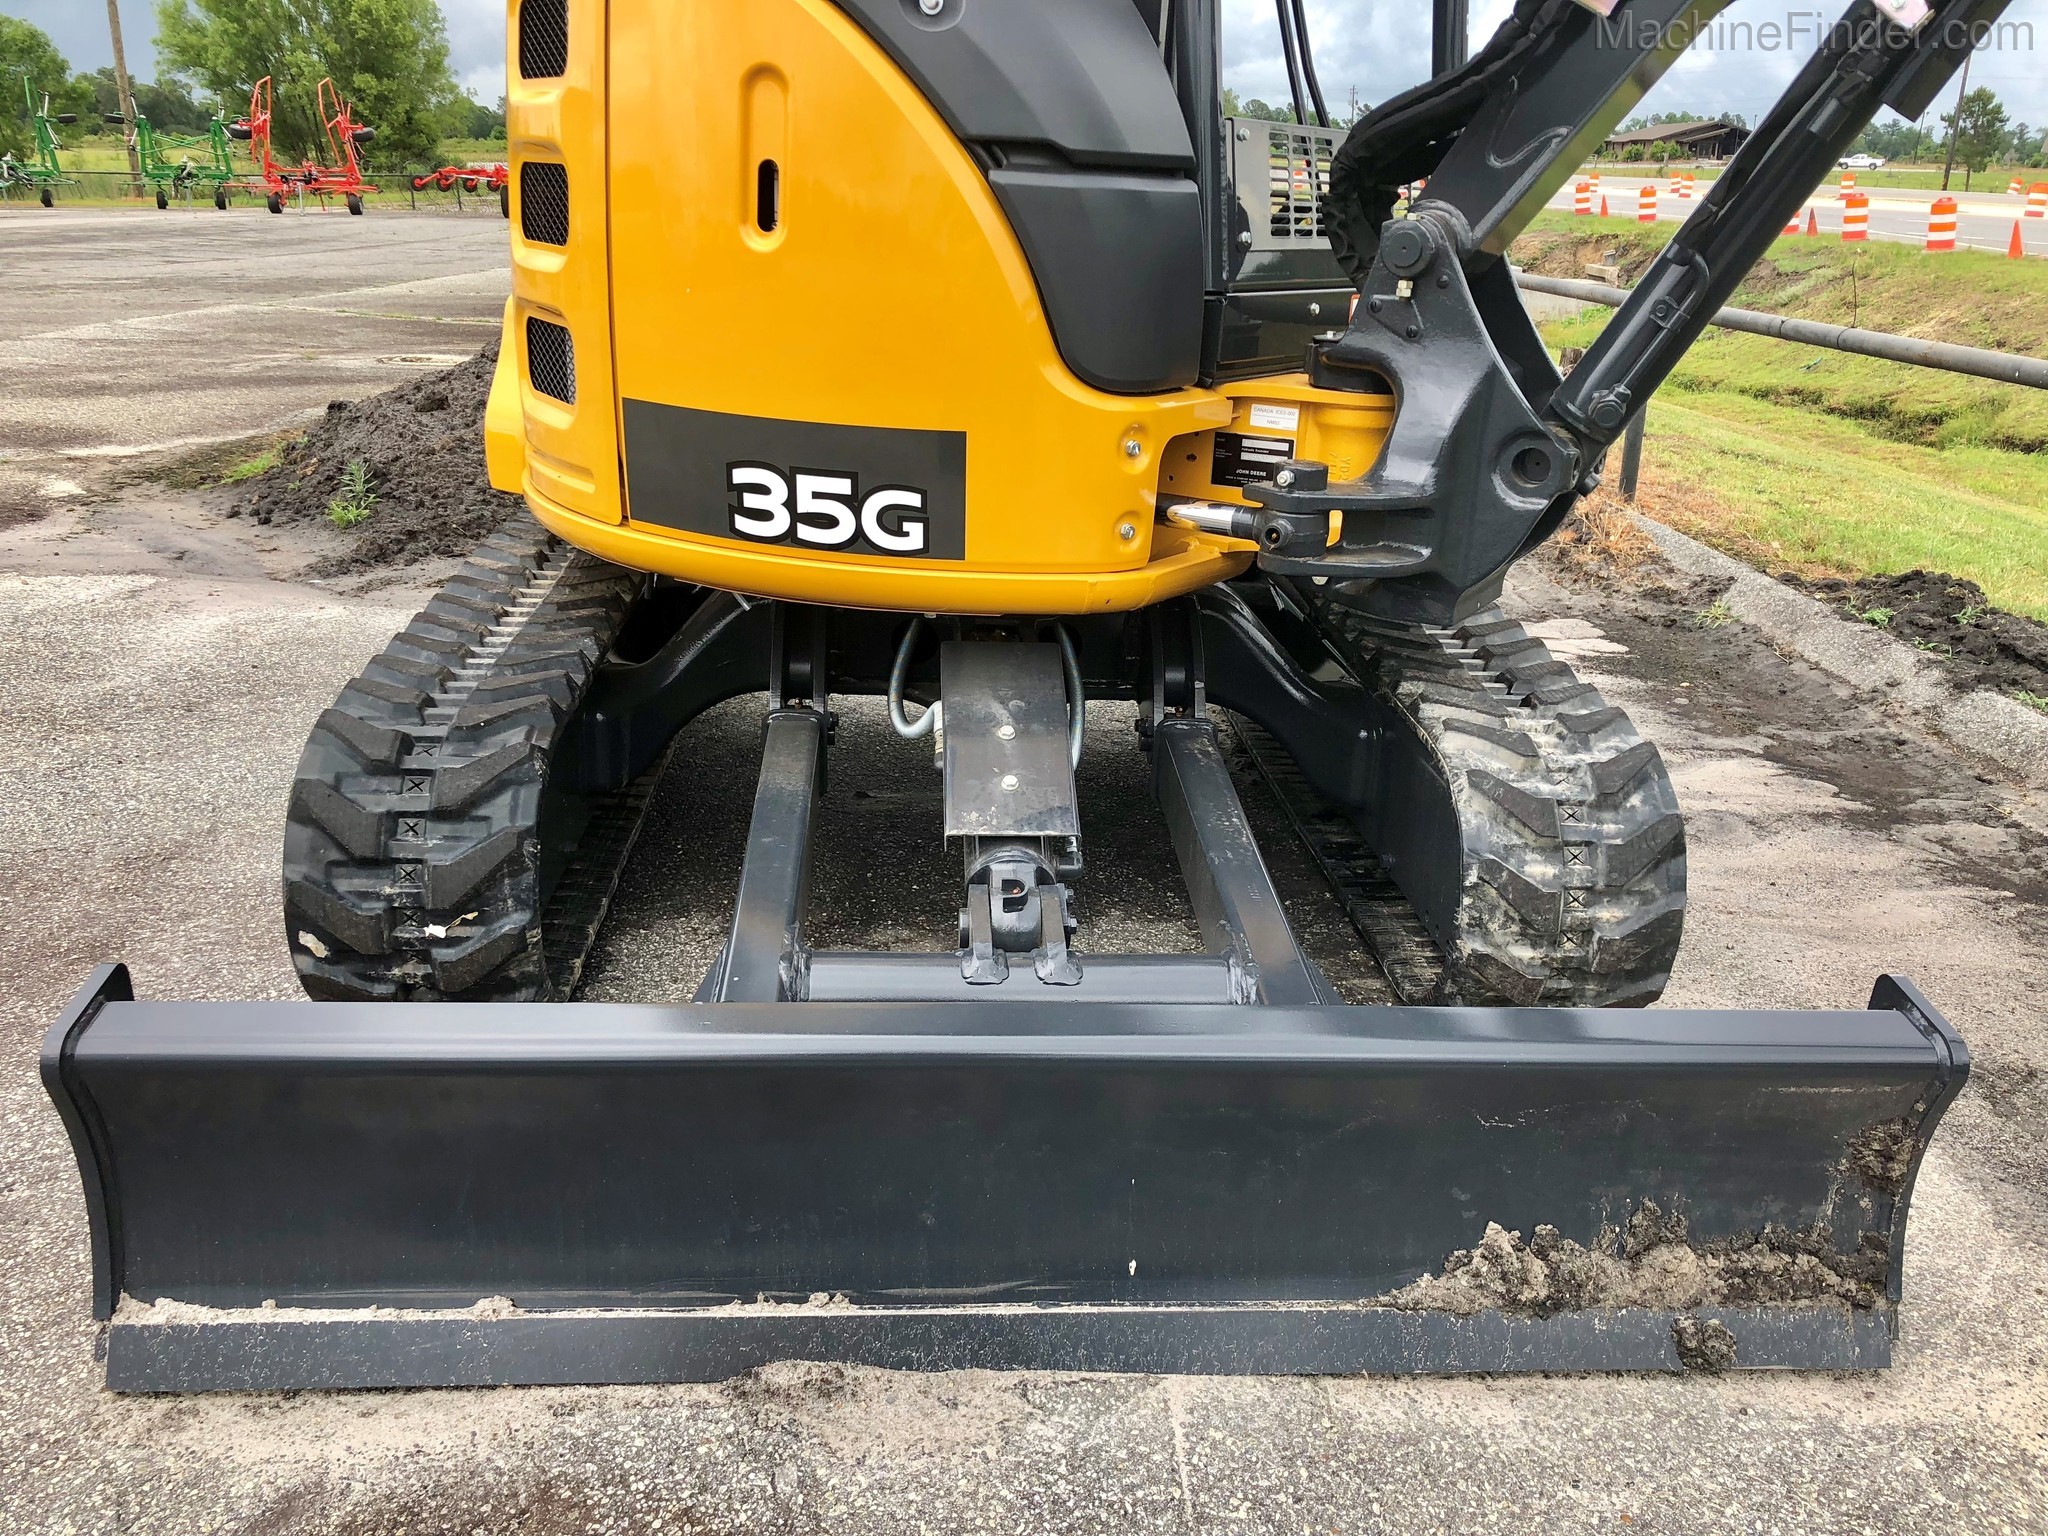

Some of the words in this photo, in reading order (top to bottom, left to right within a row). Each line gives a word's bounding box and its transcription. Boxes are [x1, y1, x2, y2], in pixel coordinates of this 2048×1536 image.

[1253, 406, 1273, 414] CANADA
[1250, 469, 1267, 477] DEERE
[730, 464, 926, 553] 35G
